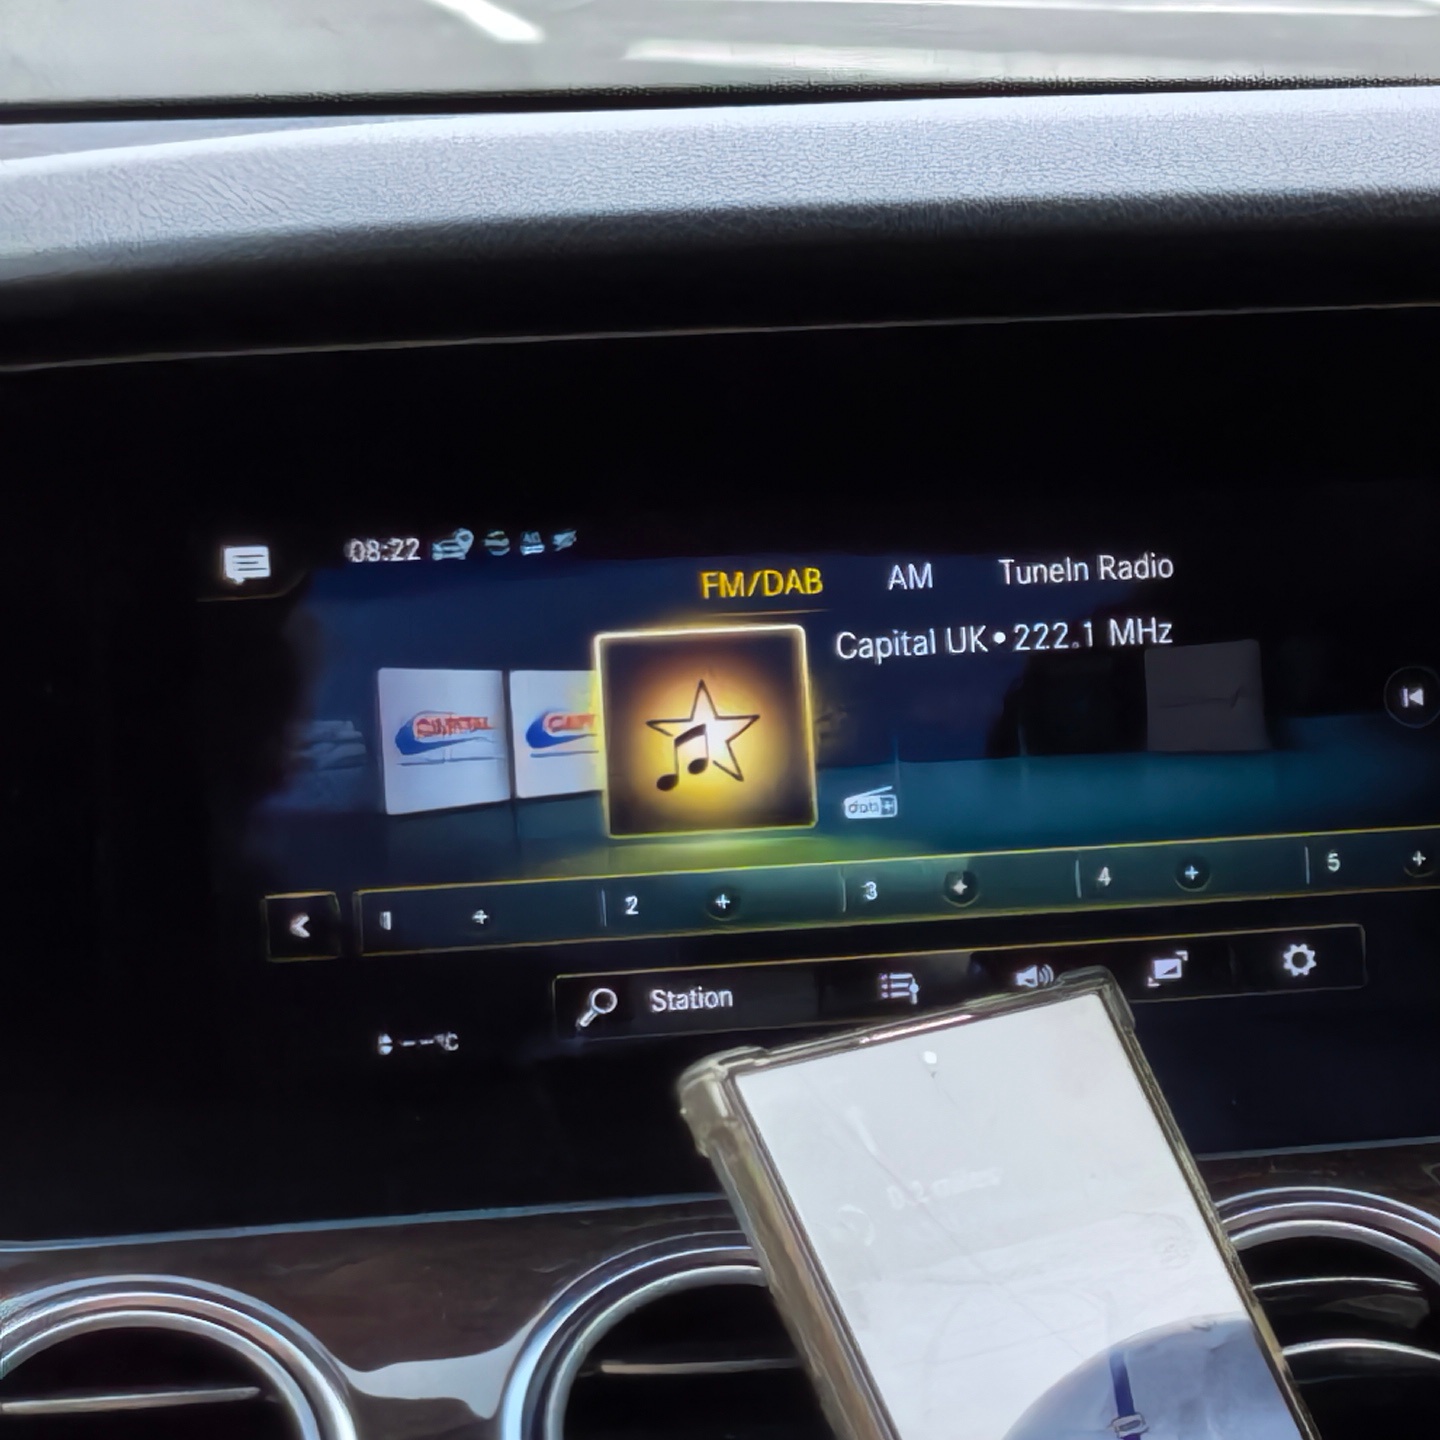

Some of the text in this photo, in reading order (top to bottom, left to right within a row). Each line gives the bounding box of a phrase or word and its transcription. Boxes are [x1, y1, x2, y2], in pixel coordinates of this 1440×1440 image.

[346, 537, 421, 562] 08:22
[701, 567, 824, 599] FM/DAB
[888, 562, 934, 590] AM
[1100, 551, 1175, 581] Radio
[836, 627, 937, 665] Capital
[946, 625, 988, 655] UK
[1108, 615, 1174, 647] MHz
[624, 895, 639, 915] 2
[864, 880, 878, 900] 3
[1097, 867, 1111, 885] 4
[1327, 853, 1340, 872] 5
[649, 986, 734, 1013] Station
